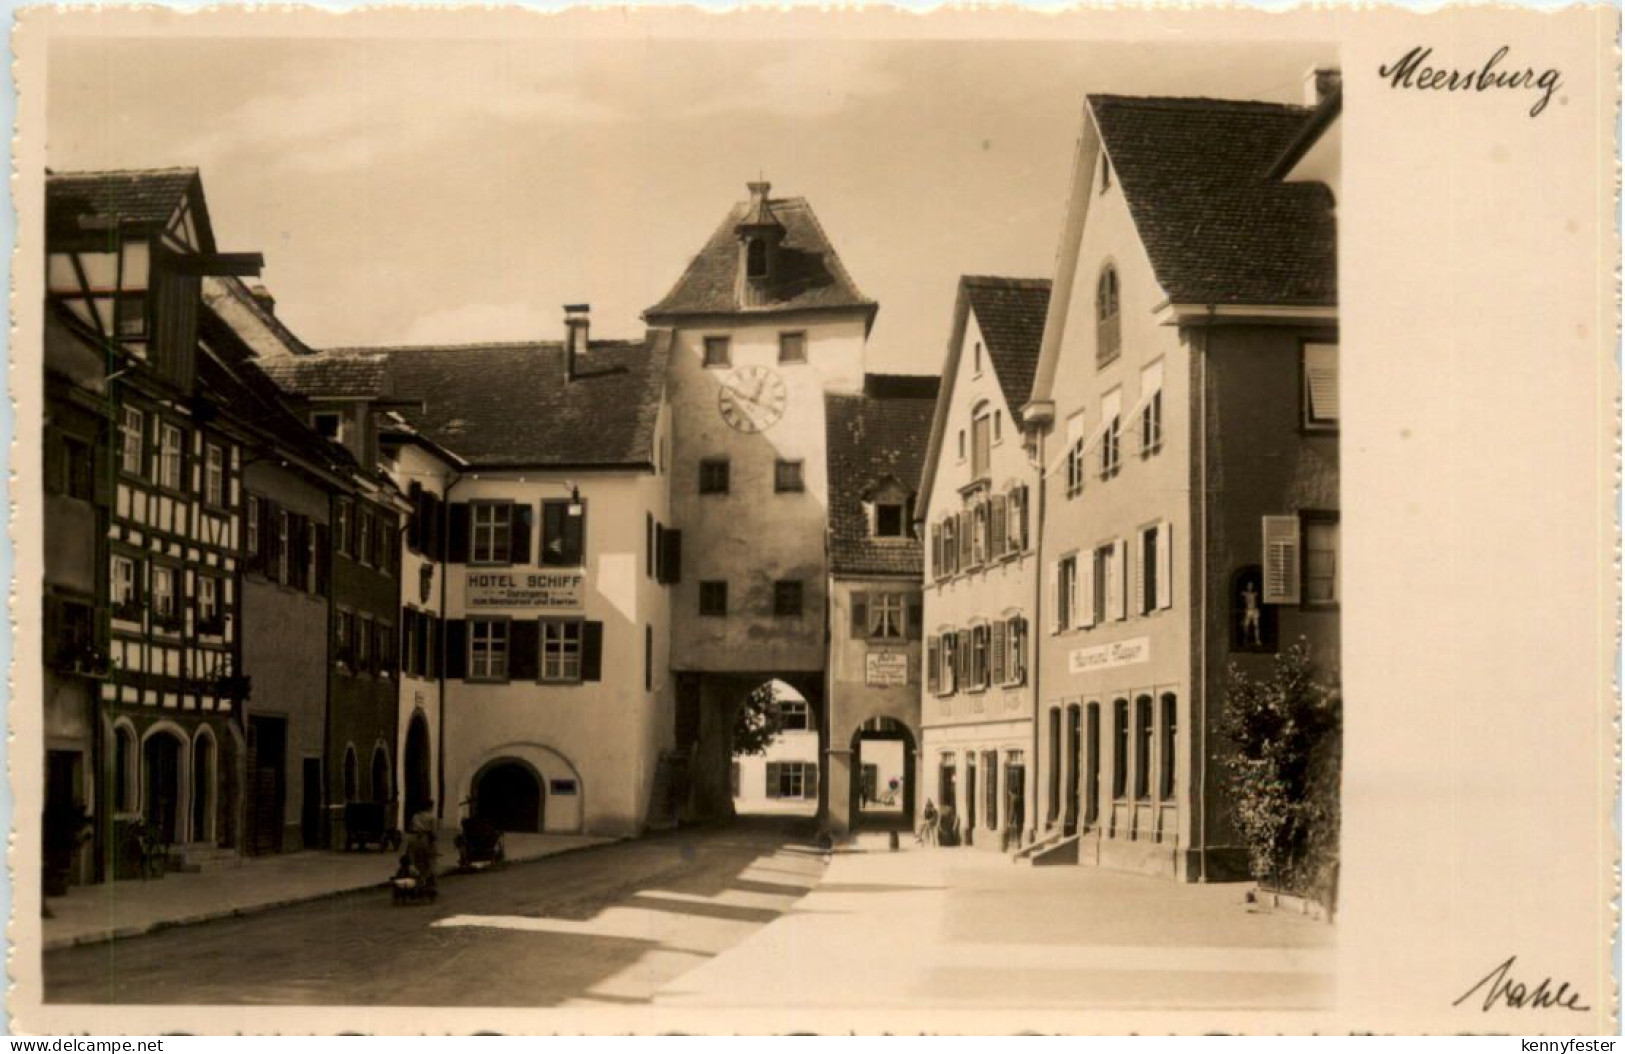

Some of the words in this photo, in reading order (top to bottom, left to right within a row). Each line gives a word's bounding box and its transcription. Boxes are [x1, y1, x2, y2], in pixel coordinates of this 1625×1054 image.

[1379, 46, 1564, 117] Meersburg
[468, 575, 516, 588] HOTEL
[527, 575, 583, 588] SCHIFF
